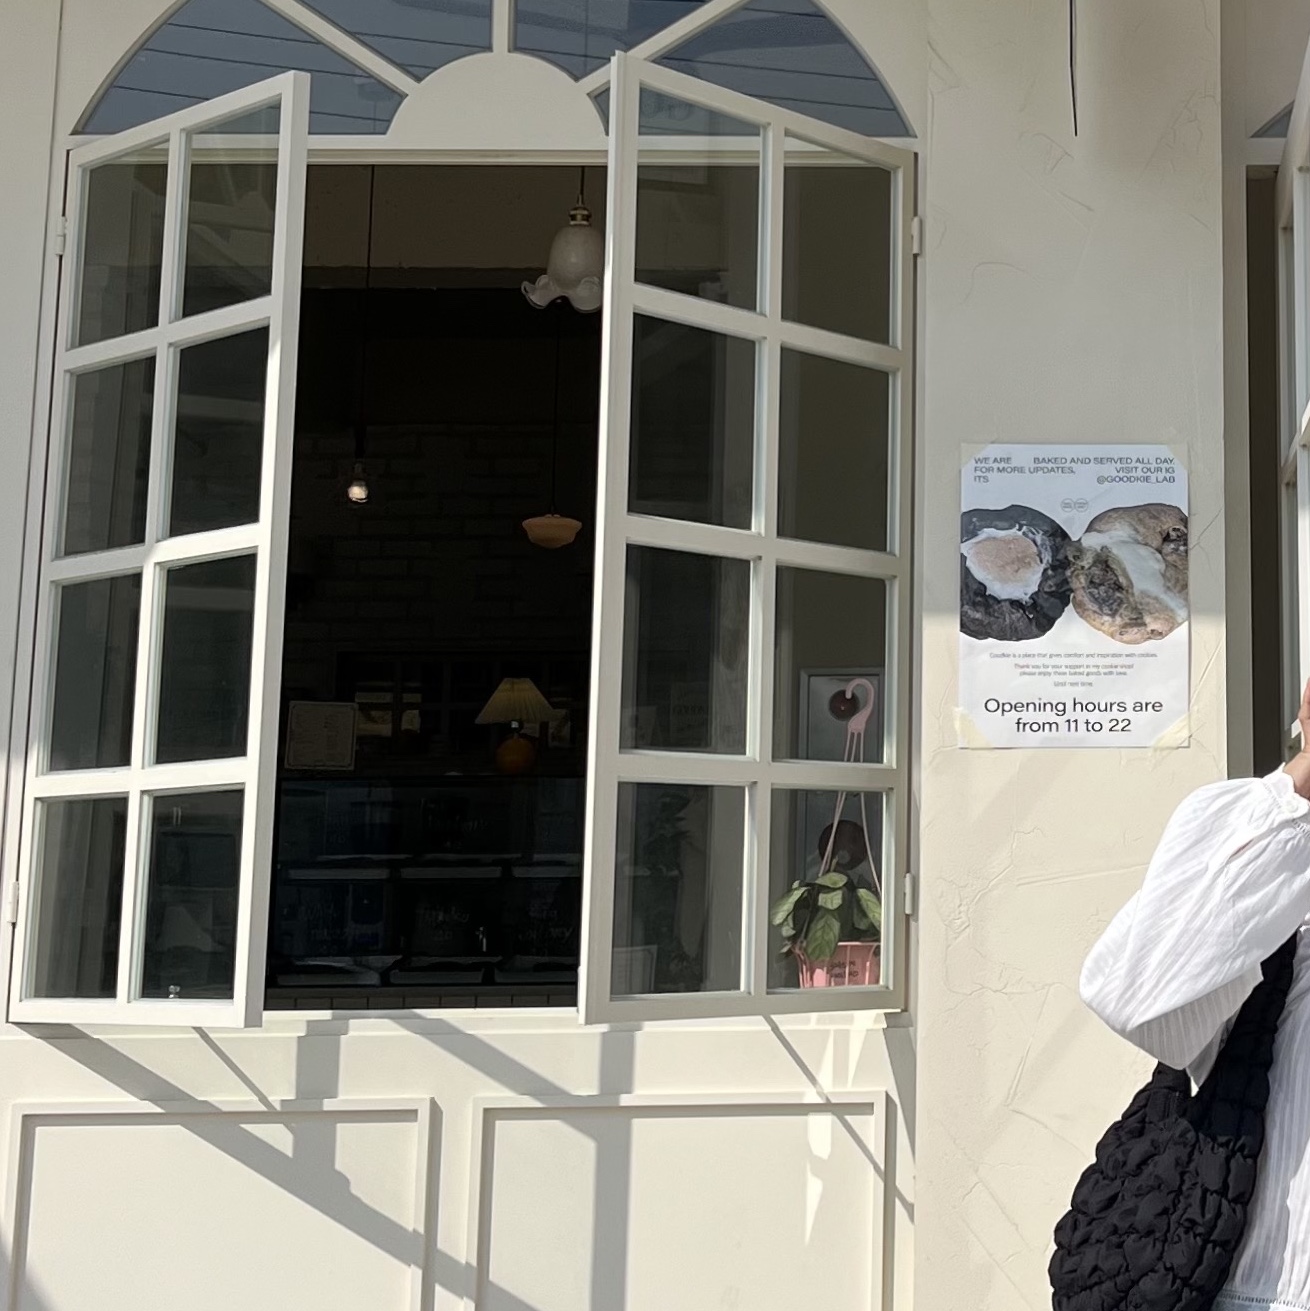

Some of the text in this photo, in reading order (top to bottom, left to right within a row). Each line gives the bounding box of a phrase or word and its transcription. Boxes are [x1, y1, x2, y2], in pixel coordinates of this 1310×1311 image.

[973, 456, 991, 465] WE
[991, 456, 1012, 465] ARE
[1033, 456, 1068, 465] BAKED
[1069, 456, 1092, 465] AND
[1093, 456, 1133, 465] SERVED
[1134, 456, 1154, 465] ALL
[973, 465, 995, 475] FOR
[996, 465, 1027, 475] MORE
[1114, 465, 1140, 475] VISIT
[1140, 465, 1163, 475] OUR
[1164, 465, 1176, 475] IG
[973, 474, 990, 484] ITS
[984, 697, 1164, 717] Opening hours are
[1014, 717, 1132, 733] from 11 to 22
